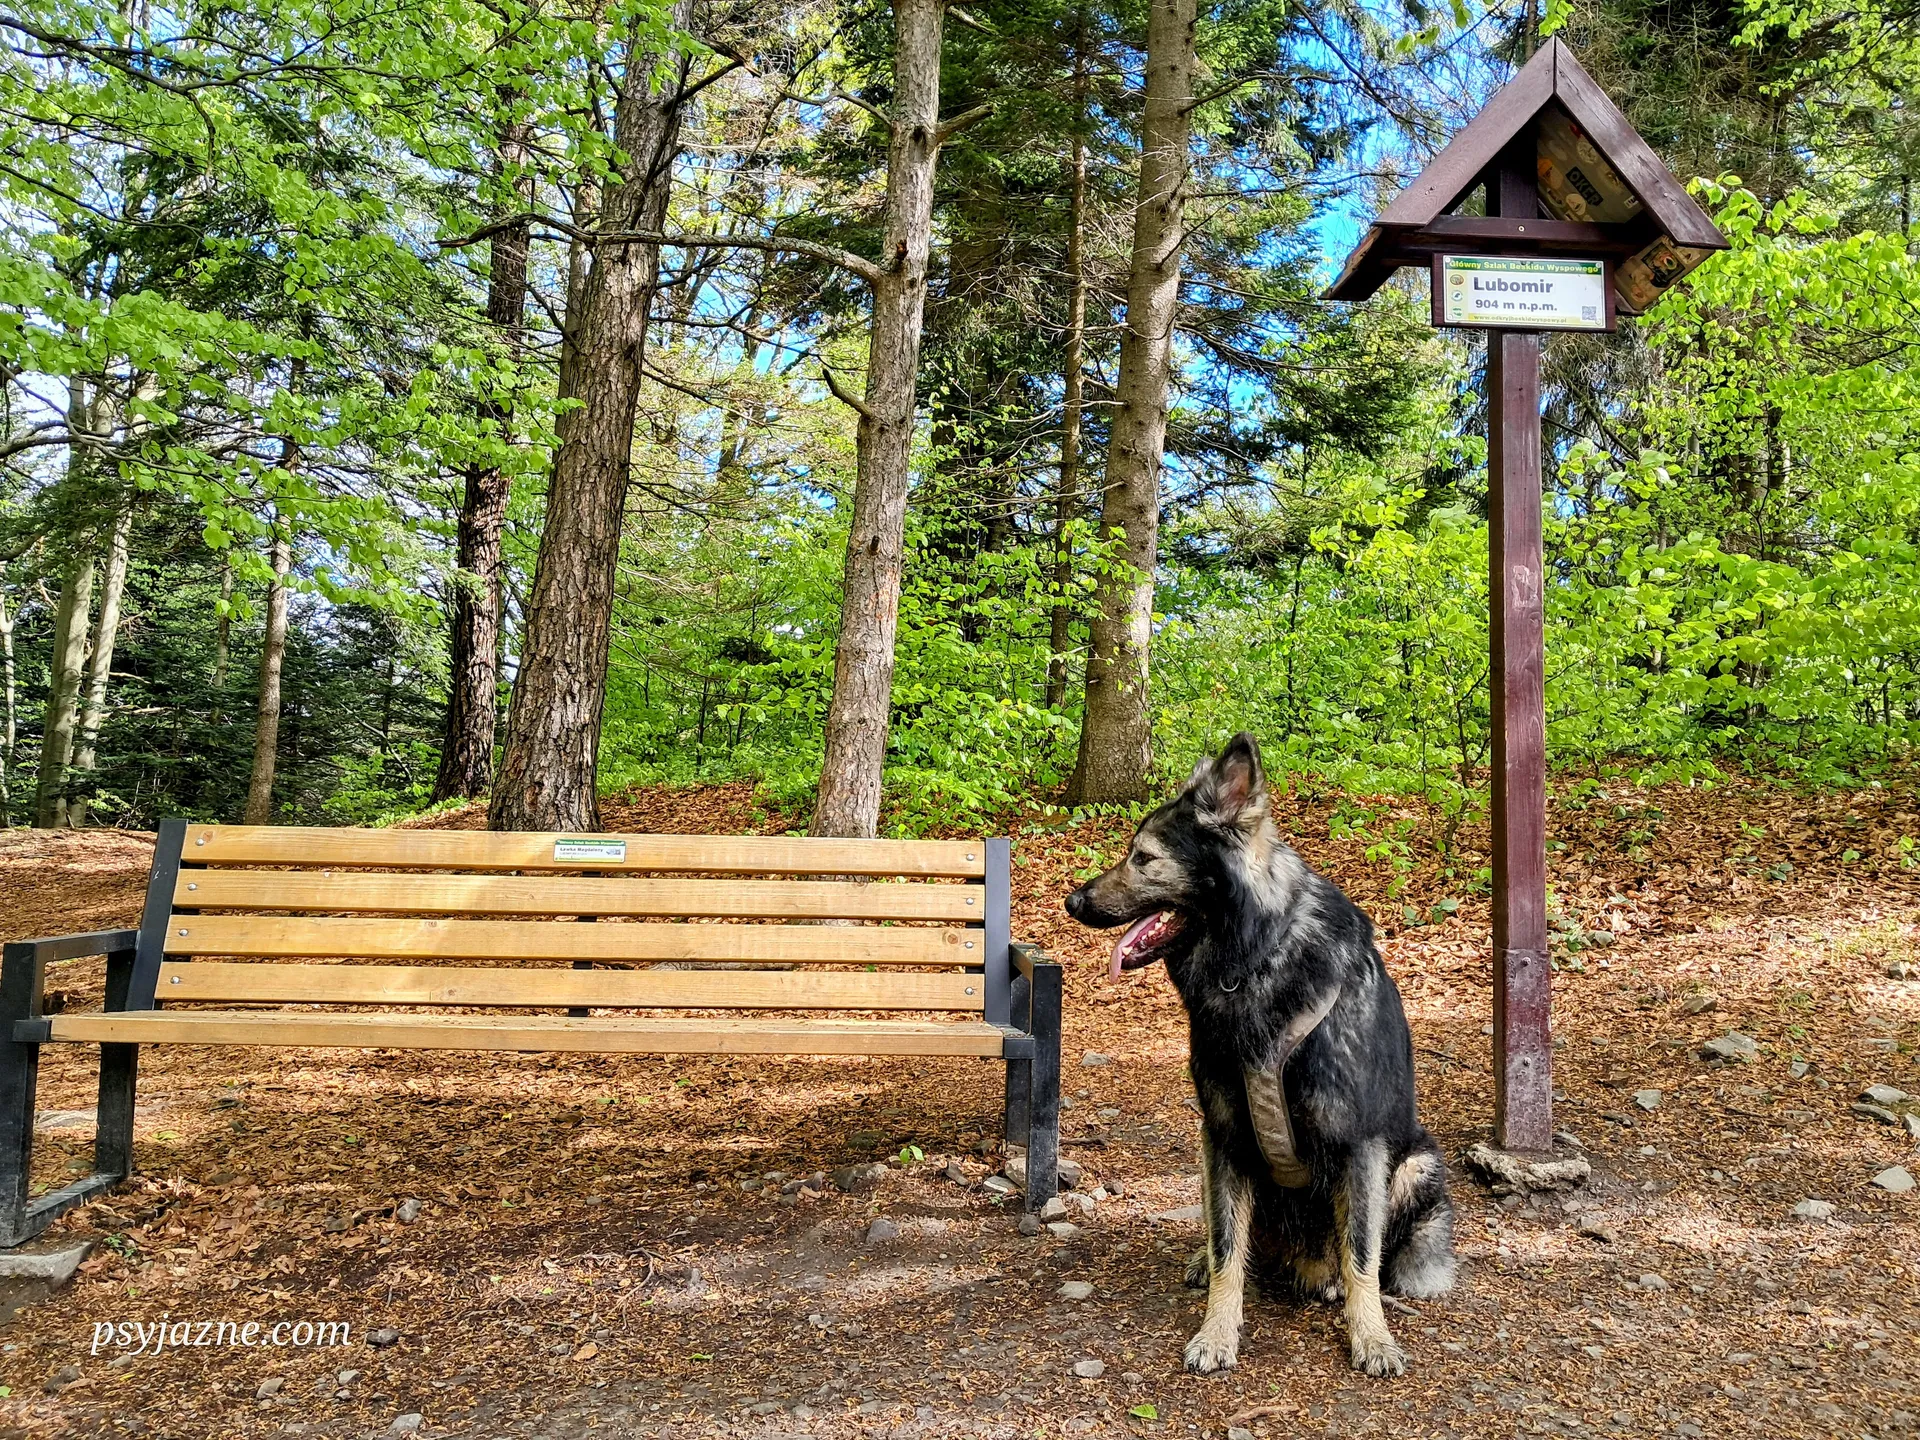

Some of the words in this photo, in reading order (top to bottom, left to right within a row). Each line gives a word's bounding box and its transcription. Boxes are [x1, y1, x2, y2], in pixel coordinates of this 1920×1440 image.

[1449, 260, 1482, 269] Główny
[1484, 261, 1507, 270] Szlak
[1510, 262, 1545, 271] Beskidu
[1547, 264, 1599, 273] Wyspowego
[1473, 276, 1553, 293] Lubomir
[1475, 299, 1499, 309] 904
[1503, 301, 1515, 310] m
[1519, 301, 1558, 312] n.p.m.
